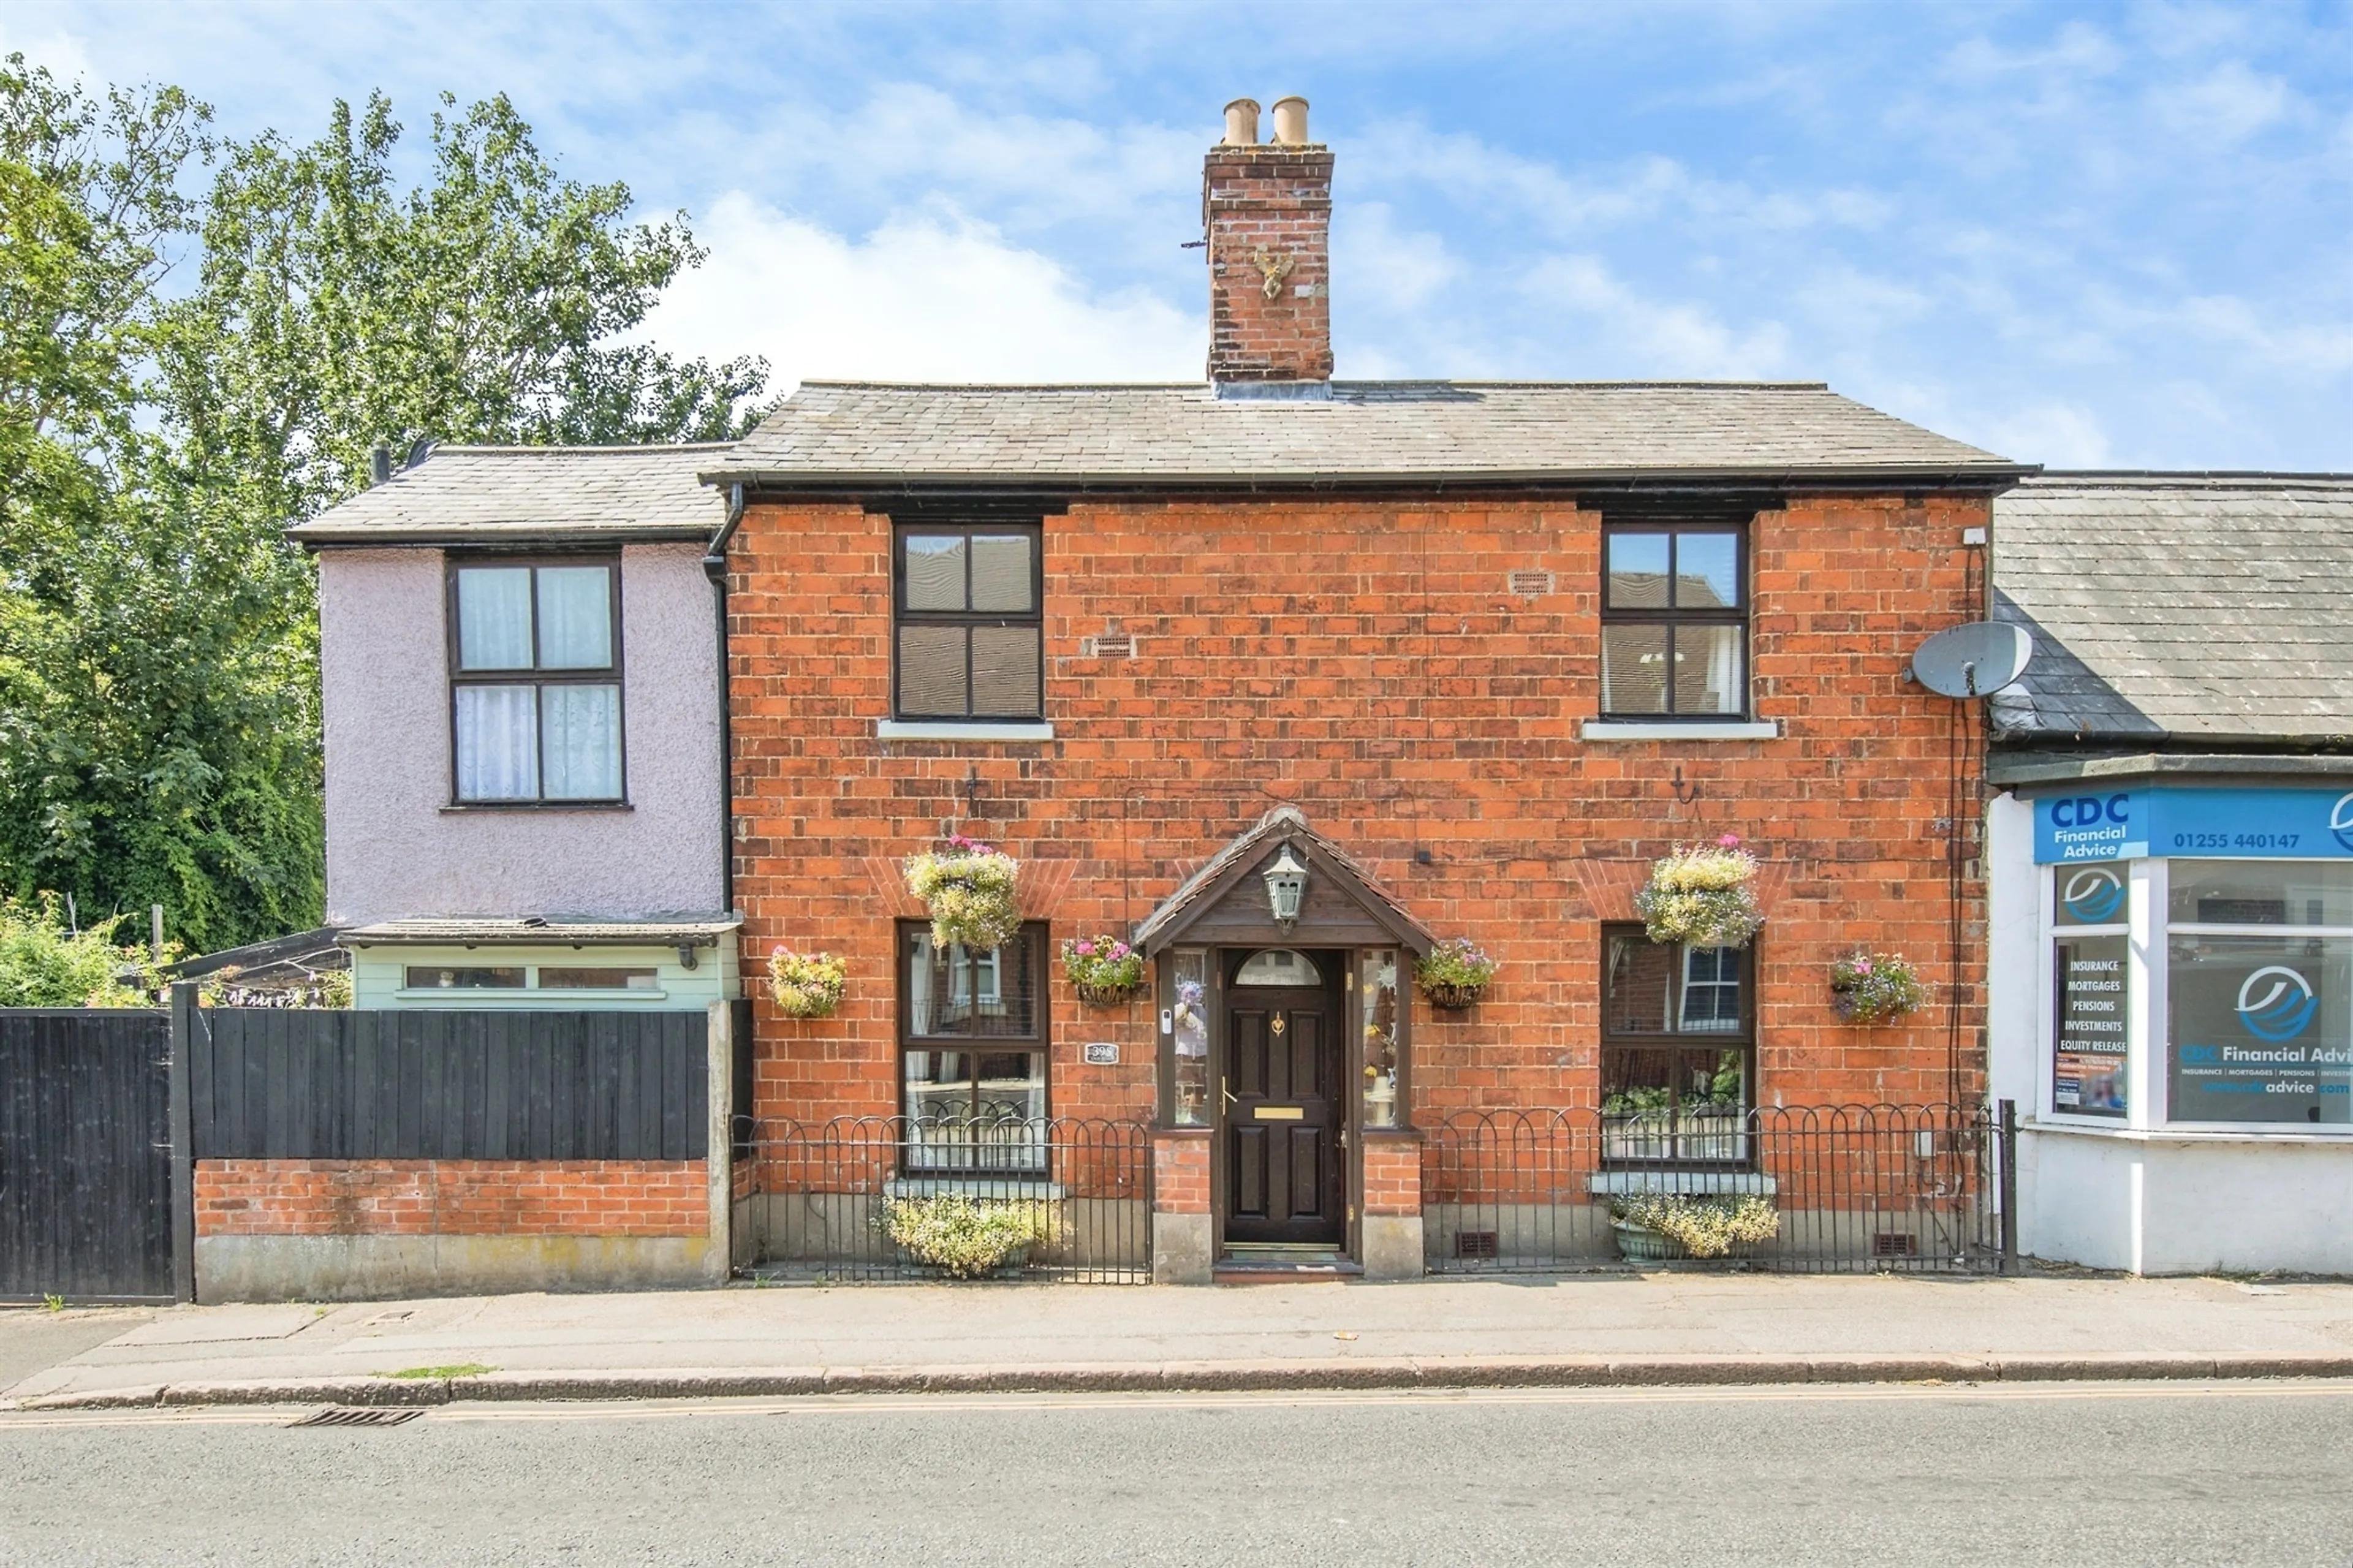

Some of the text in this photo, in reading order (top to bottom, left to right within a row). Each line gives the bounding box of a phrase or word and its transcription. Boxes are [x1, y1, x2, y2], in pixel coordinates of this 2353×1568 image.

[2051, 793, 2129, 828] CDC
[2055, 825, 2126, 843] Financial
[2174, 833, 2300, 848] 01255 440147
[2064, 844, 2116, 858] Advice
[2071, 961, 2118, 971] INSURANCE
[2068, 981, 2120, 991] MORTGAGES
[2072, 1001, 2115, 1011] PENSIONS
[2065, 1021, 2122, 1031] INVESTMENTS
[2061, 1040, 2126, 1052] EQUITY RELEASE
[2222, 1047, 2305, 1062] Financial
[2310, 1047, 2353, 1062] Advi
